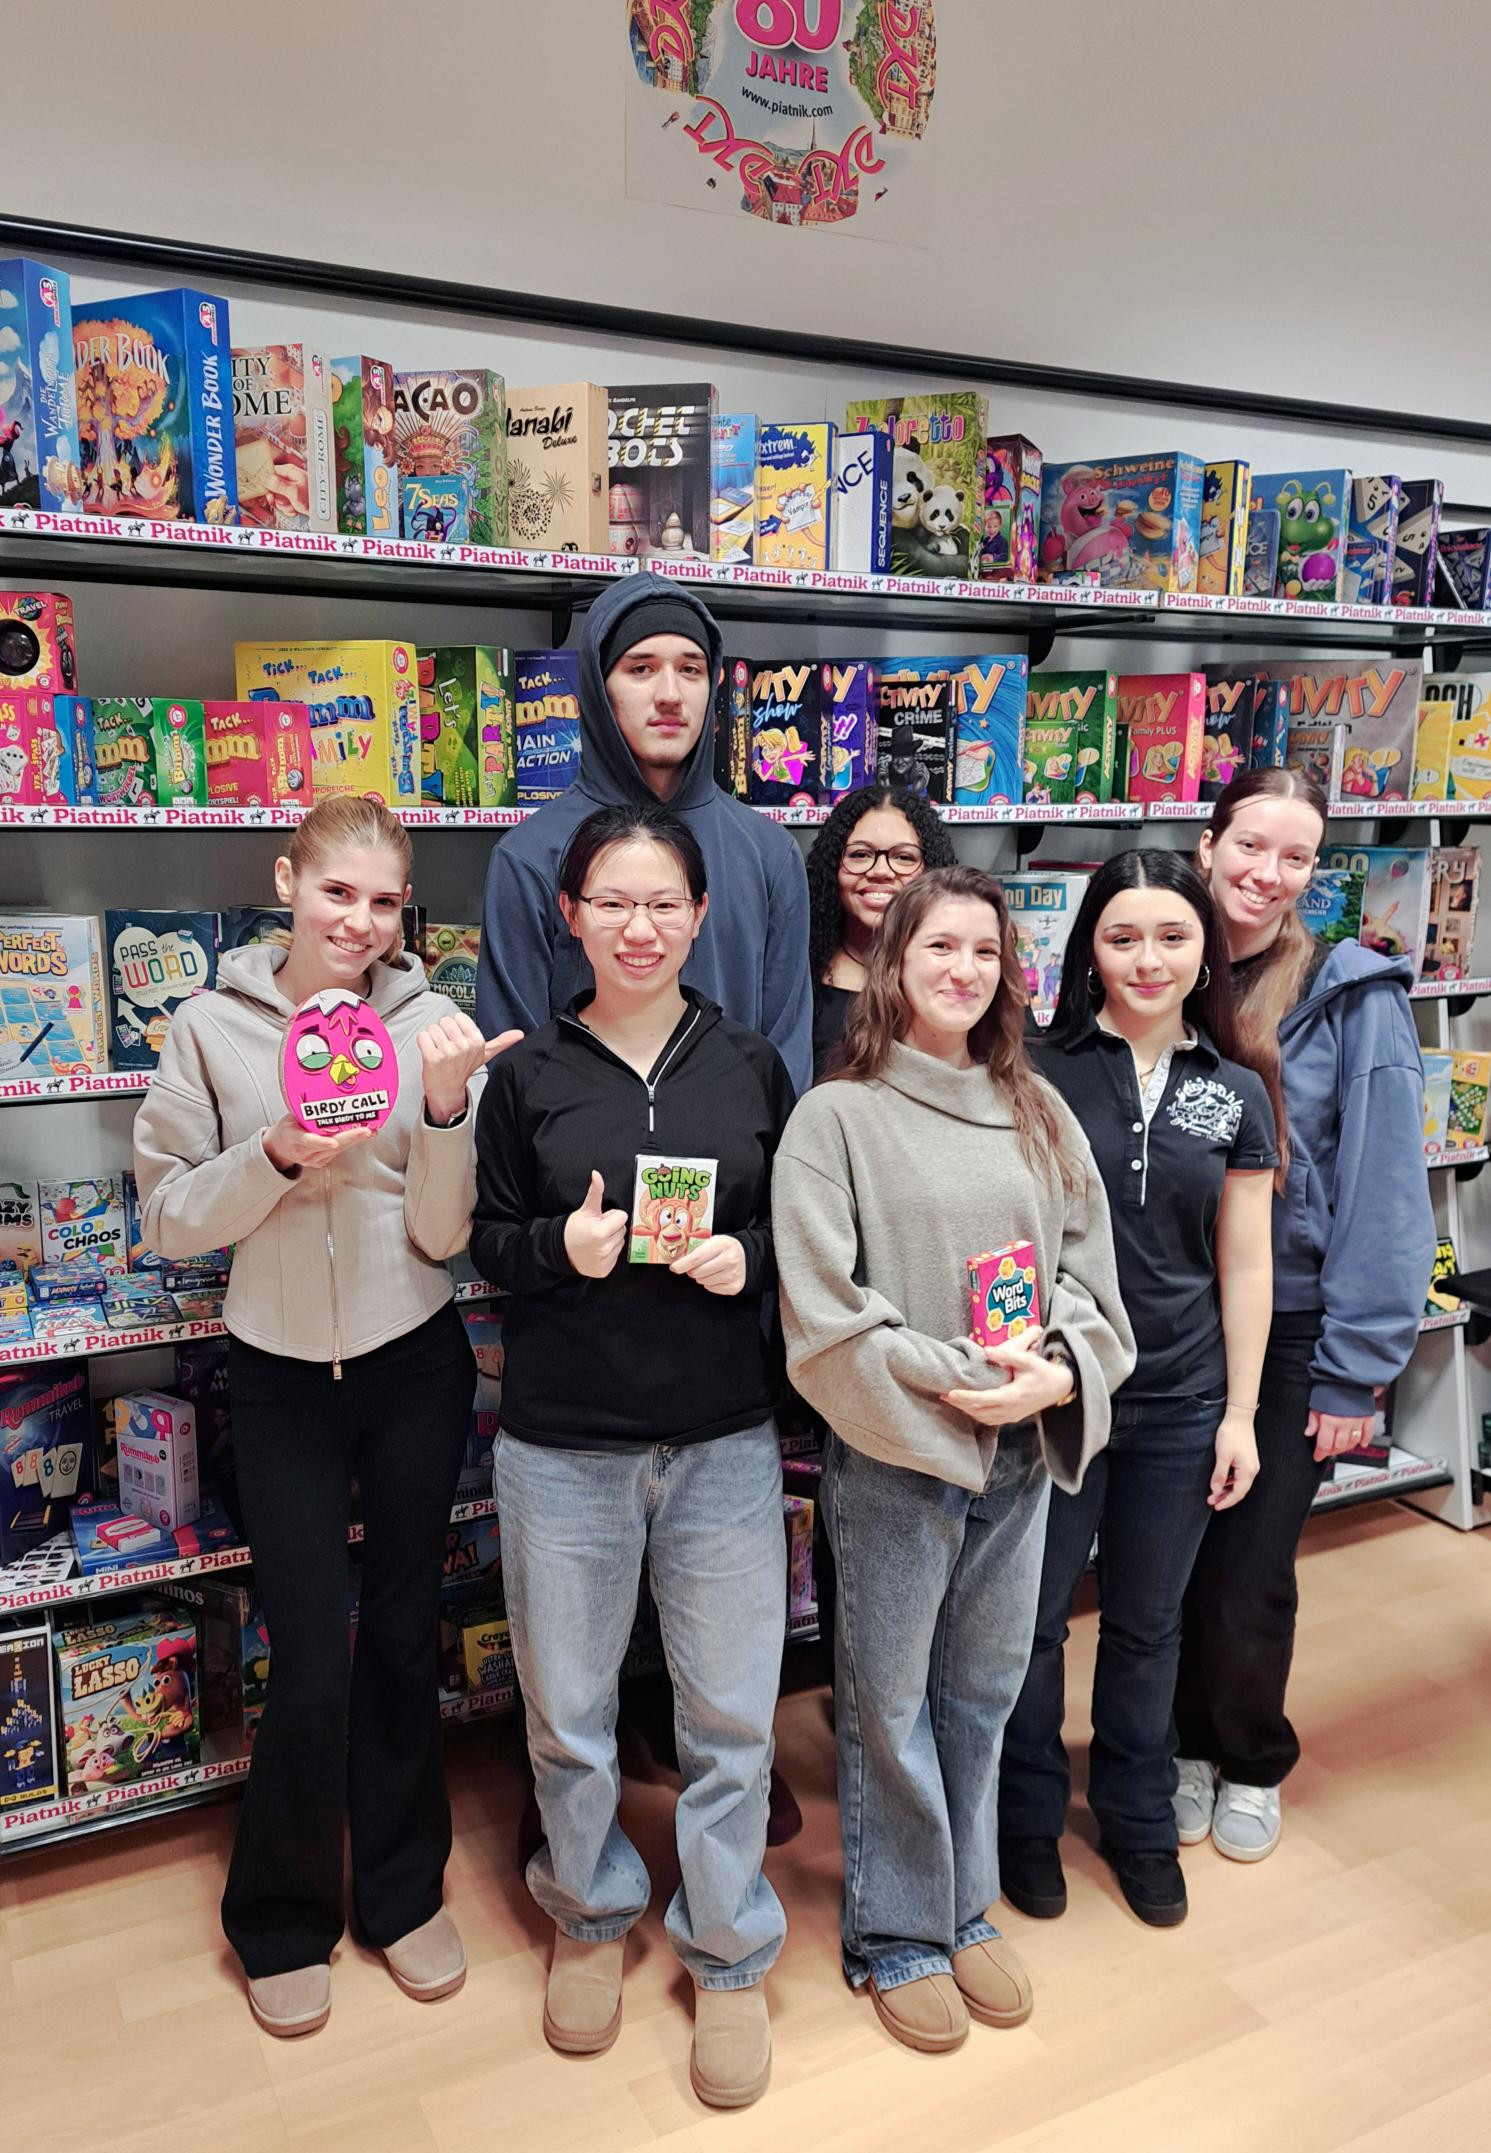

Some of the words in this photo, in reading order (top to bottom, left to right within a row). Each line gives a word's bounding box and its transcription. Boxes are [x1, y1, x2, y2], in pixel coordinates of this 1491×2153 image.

[745, 51, 829, 94] JAHRE
[740, 85, 834, 119] www.piatnik.com
[115, 333, 171, 385] BOOK
[201, 354, 218, 411] BOOK
[542, 435, 578, 450] Deluxe
[204, 413, 227, 498] WONDER
[1093, 458, 1175, 479] Schweine
[877, 479, 889, 567] SEQUENCE
[35, 513, 122, 536] Piatnik
[150, 526, 233, 544] Piatnik
[260, 531, 337, 552] Piatnik
[362, 537, 436, 560] Piatnik
[459, 546, 530, 568] Piatnik
[551, 552, 617, 573] Piatnik
[651, 559, 714, 580] Piatnik
[733, 566, 792, 584] Piatnik
[811, 572, 868, 590] Piatnik
[886, 578, 941, 594] Piatnik
[958, 583, 1010, 599] Piatnik
[1027, 587, 1077, 602] Piatnik
[1093, 590, 1141, 604] Piatnik
[1167, 594, 1213, 608] Piatnik
[1228, 598, 1271, 612] Piatnik
[1285, 602, 1328, 616] Piatnik
[1341, 606, 1382, 619] Piatnik
[1395, 609, 1434, 622] Piatnik
[1447, 612, 1485, 625] Piatnik
[14, 601, 47, 616] TRAVEL
[518, 671, 565, 690] TACK...
[438, 678, 462, 728] Let's
[516, 694, 581, 728] mm
[753, 693, 803, 728] show
[1156, 726, 1177, 736] PLUS
[517, 751, 571, 768] ACTION
[53, 808, 138, 824] Piatnik
[166, 808, 245, 825] Piatnik
[948, 807, 999, 820] Piatnik
[1015, 804, 1064, 818] Piatnik
[1080, 803, 1127, 817] Piatnik
[1152, 803, 1197, 816] Piatnik
[1376, 803, 1416, 815] Piatnik
[1429, 802, 1466, 813] Piatnik
[1030, 887, 1063, 910] Day
[120, 941, 158, 962] PASS
[162, 943, 175, 954] the
[124, 950, 199, 989] WORD
[430, 984, 476, 1000] HOCOLA
[69, 1074, 150, 1092] Piatnik
[303, 1100, 346, 1117] BIRDY
[351, 1093, 386, 1109] CALL
[317, 1118, 334, 1126] TALK
[335, 1115, 354, 1124] BIRDY
[355, 1112, 365, 1120] TO
[366, 1111, 377, 1119] ME
[648, 1182, 702, 1201] NUTS
[48, 1220, 105, 1241] COLOR
[64, 1228, 121, 1250] CHAOS
[992, 1277, 1025, 1303] Word
[1004, 1295, 1027, 1315] Bits
[85, 1328, 164, 1350] Piatnik
[0, 1372, 85, 1431] Rummikub
[49, 1399, 85, 1422] TRAVEL
[120, 1442, 160, 1465] Rummikub
[43, 1459, 54, 1477] 8
[95, 1565, 119, 1575] MINI
[99, 1565, 175, 1589] Piatnik
[74, 1655, 111, 1677] LUCKY
[74, 1659, 140, 1700] LASSO
[4, 1802, 81, 1830] Piatnik
[106, 1776, 180, 1804] Piatnik
